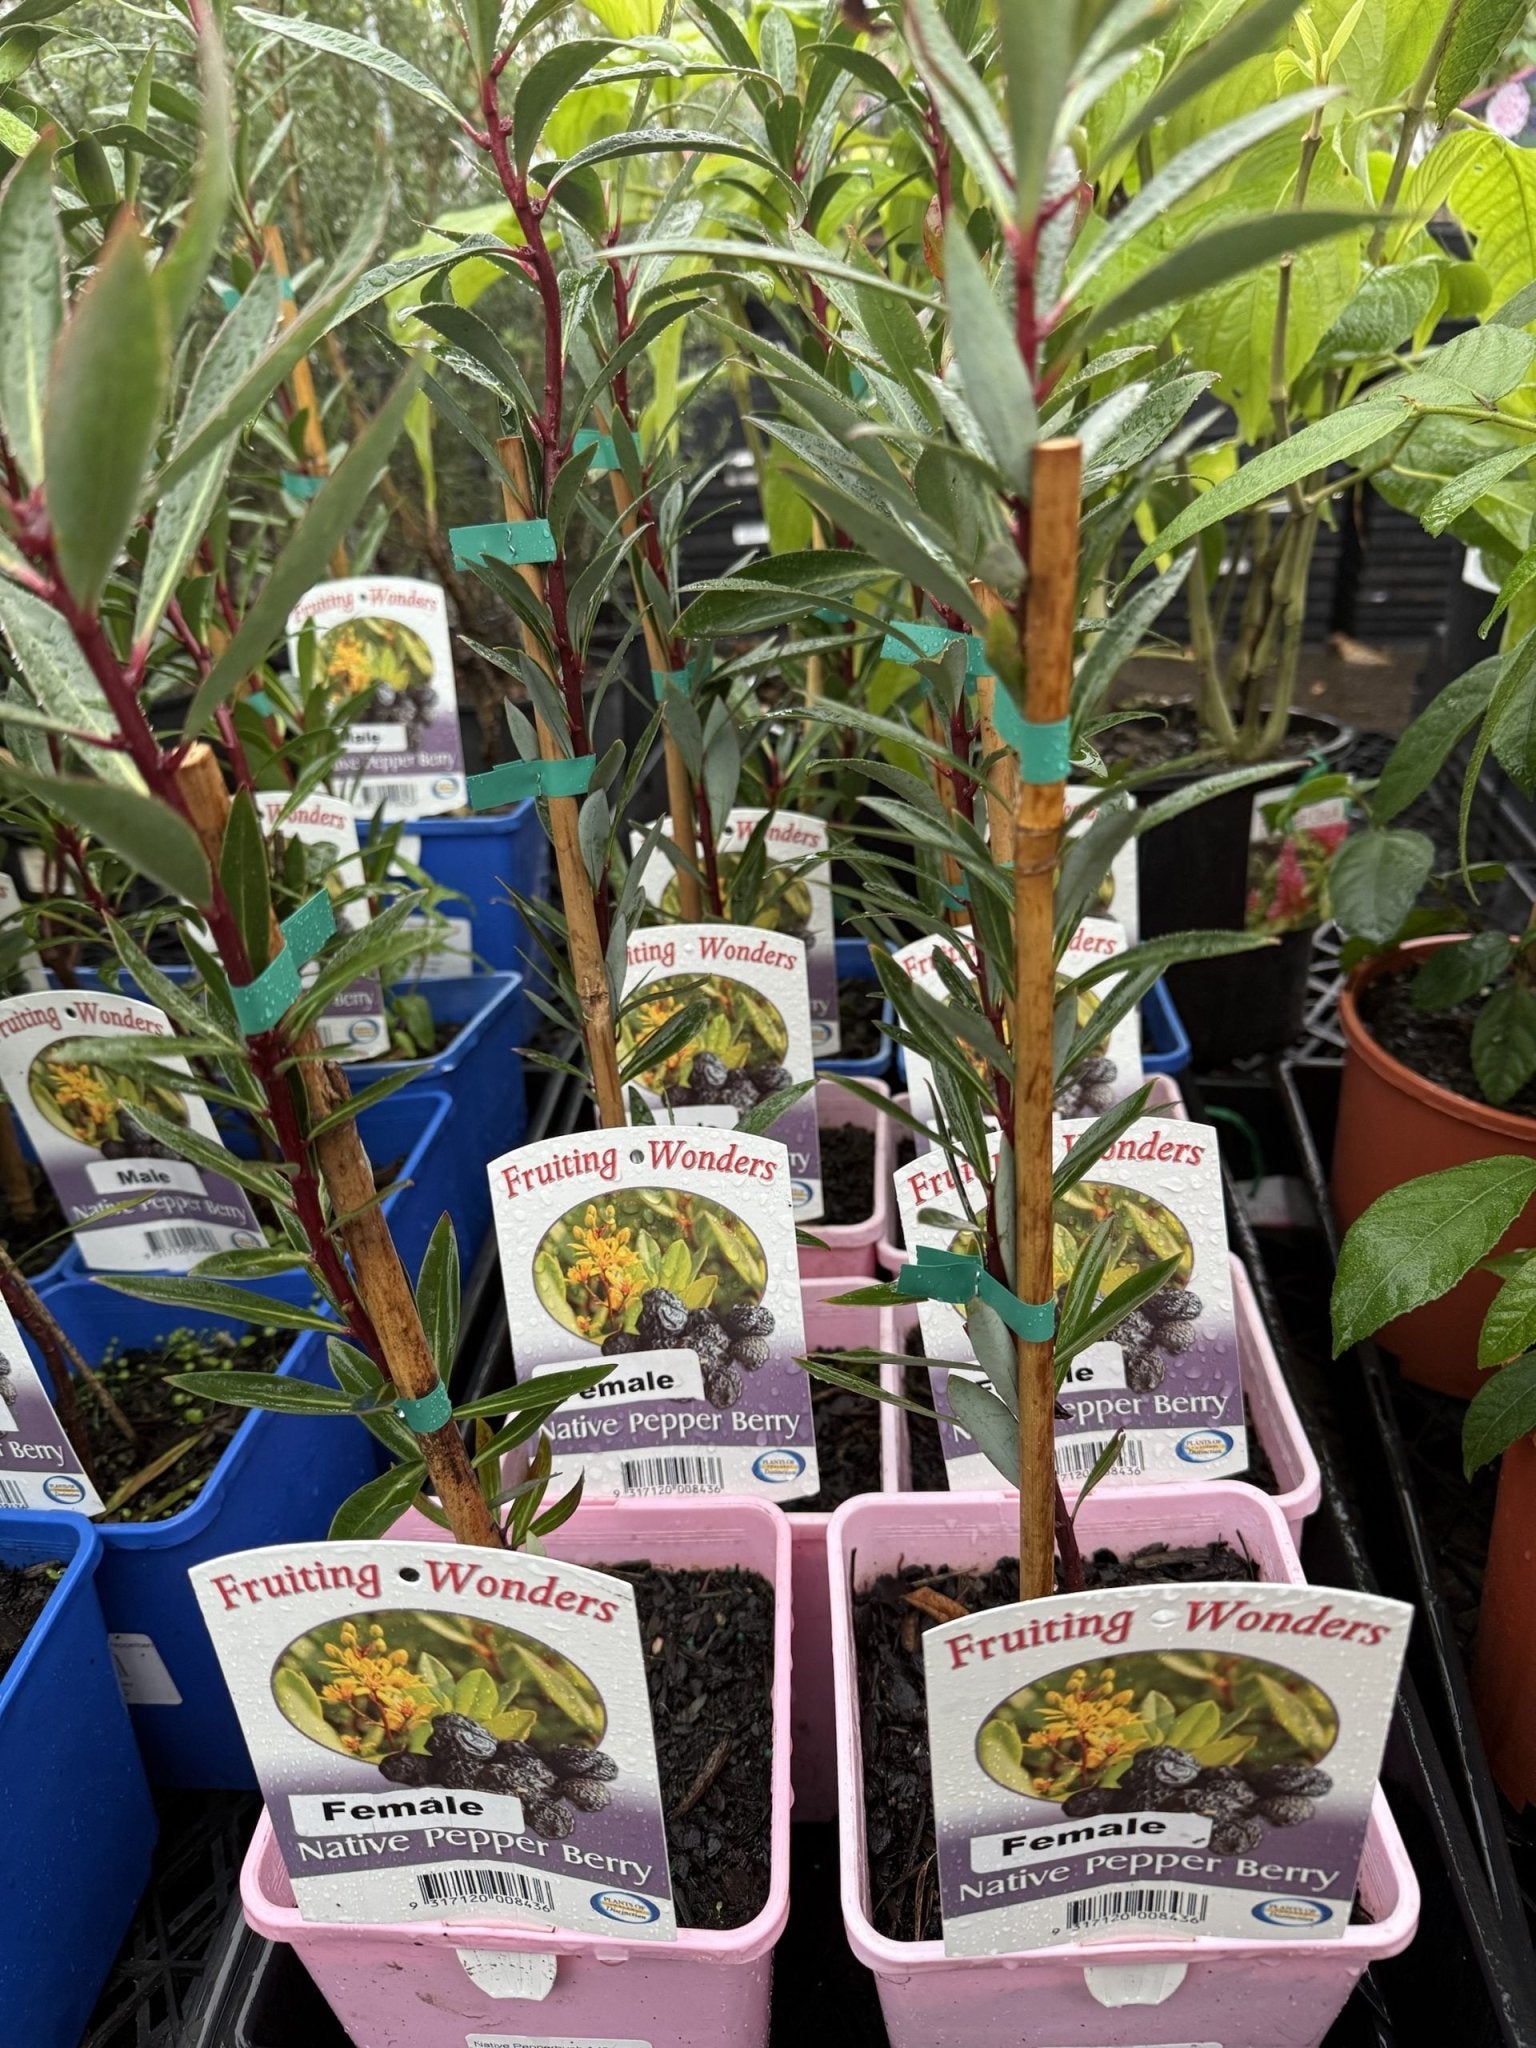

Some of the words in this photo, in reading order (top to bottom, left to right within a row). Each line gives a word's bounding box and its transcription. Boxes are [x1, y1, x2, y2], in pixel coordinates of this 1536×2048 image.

[736, 820, 821, 848] Wnders
[627, 942, 676, 968] iting
[698, 936, 797, 970] Wonders
[1068, 928, 1117, 955] ders
[0, 1006, 62, 1038] ruiting
[73, 1001, 164, 1037] Wonders
[116, 1169, 171, 1185] Male
[501, 1147, 618, 1199] Fruiting
[648, 1139, 778, 1181] Wonders
[579, 1371, 674, 1400] emale
[1063, 1396, 1141, 1425] epper
[1154, 1394, 1229, 1419] Berry
[629, 1412, 722, 1440] Pepper
[732, 1411, 800, 1440] Berry
[8, 1441, 64, 1467] Berry
[613, 1488, 620, 1498] 9
[628, 1485, 672, 1497] 317120
[677, 1484, 721, 1494] 008436
[211, 1560, 382, 1611] Fruiting
[425, 1560, 620, 1624] Wonders
[945, 1603, 1135, 1670] Fruiting
[1186, 1600, 1391, 1647] Wonders
[322, 1796, 485, 1822] Female
[1001, 1817, 1167, 1857] Female
[297, 1834, 410, 1863] Native
[425, 1827, 550, 1857] Pepper
[563, 1844, 653, 1886] Berry
[959, 1863, 1070, 1902] Native
[1086, 1851, 1221, 1877] Pepper
[1236, 1858, 1341, 1887] Berry
[409, 1901, 418, 1910] 9
[430, 1894, 488, 1908] 317120
[495, 1895, 551, 1913] 008436
[1071, 1912, 1130, 1931] 317120
[1137, 1911, 1200, 1924] 008436
